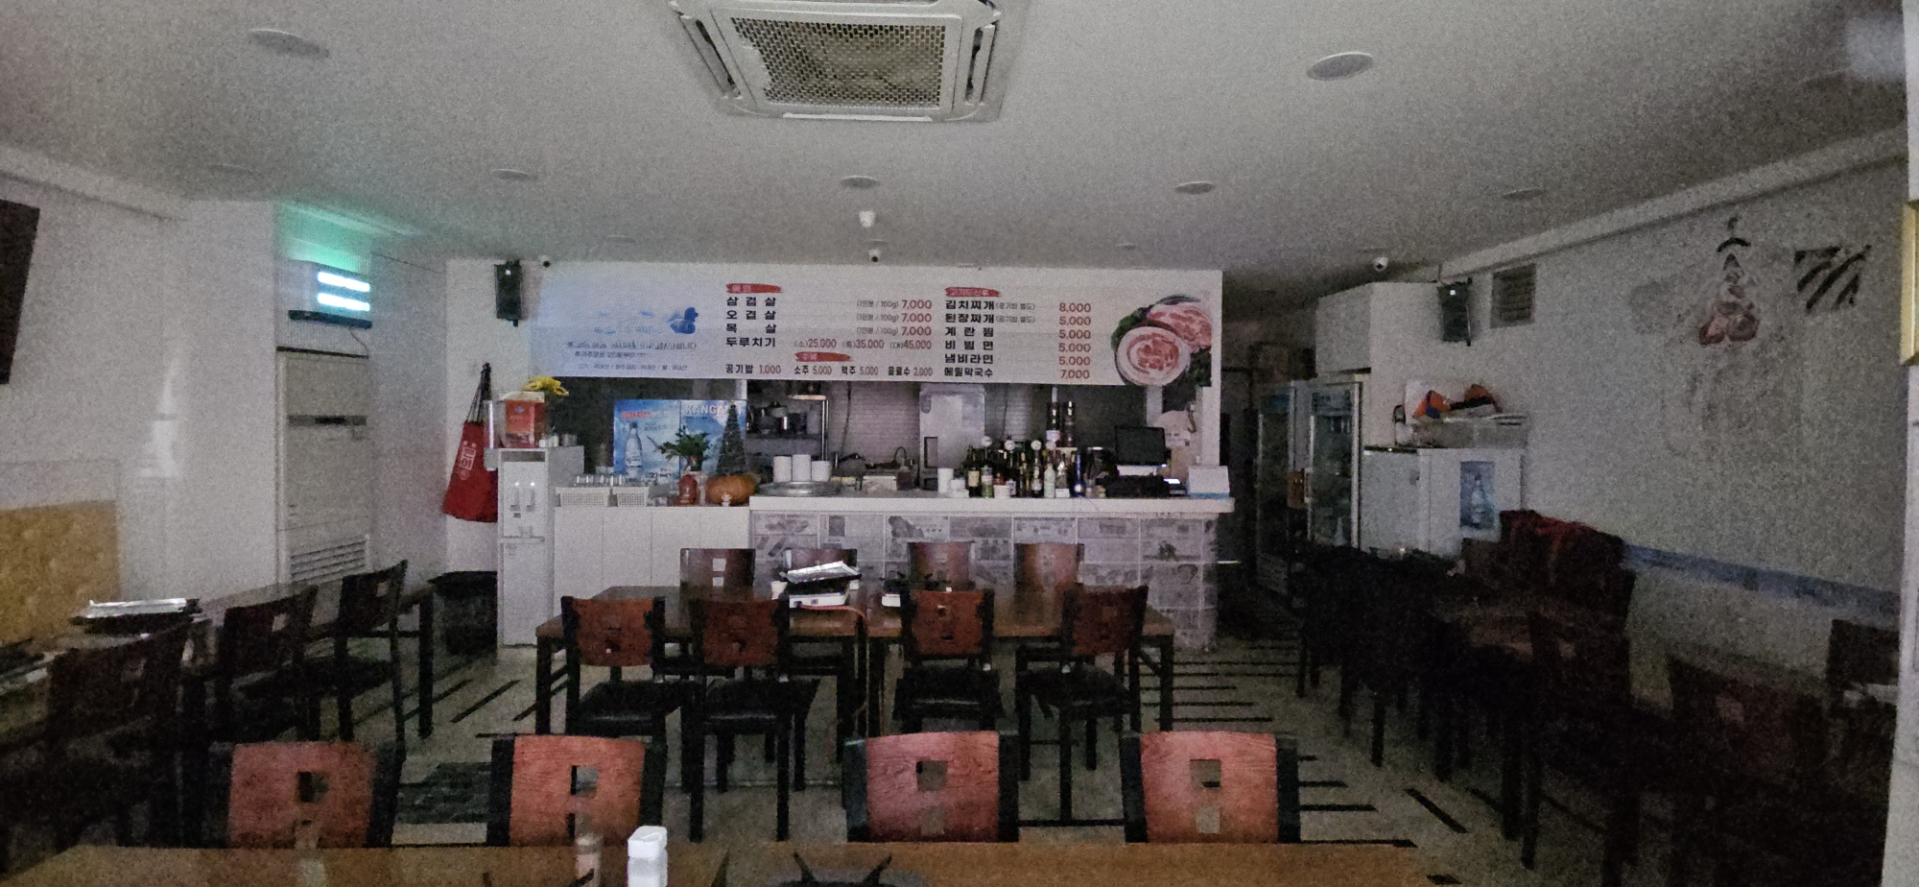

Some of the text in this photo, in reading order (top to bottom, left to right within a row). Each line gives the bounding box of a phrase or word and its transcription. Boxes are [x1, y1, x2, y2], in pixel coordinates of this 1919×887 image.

[901, 300, 933, 310] 7,000
[945, 300, 995, 310] 김치찌개
[901, 313, 933, 323] 7,000
[945, 313, 995, 324] 된장찌개
[1058, 316, 1092, 326] 5,000
[901, 326, 933, 336] 7,000
[1058, 329, 1092, 339] 5,000
[725, 337, 776, 348] 두루치기
[1058, 343, 1092, 353] 5,000
[944, 354, 1092, 366] 냄비라면 5,000
[725, 364, 754, 374] 공기밥
[793, 365, 809, 375] 소주
[841, 366, 856, 375] 맥주
[943, 367, 1090, 380] 메밀막국수 7,000
